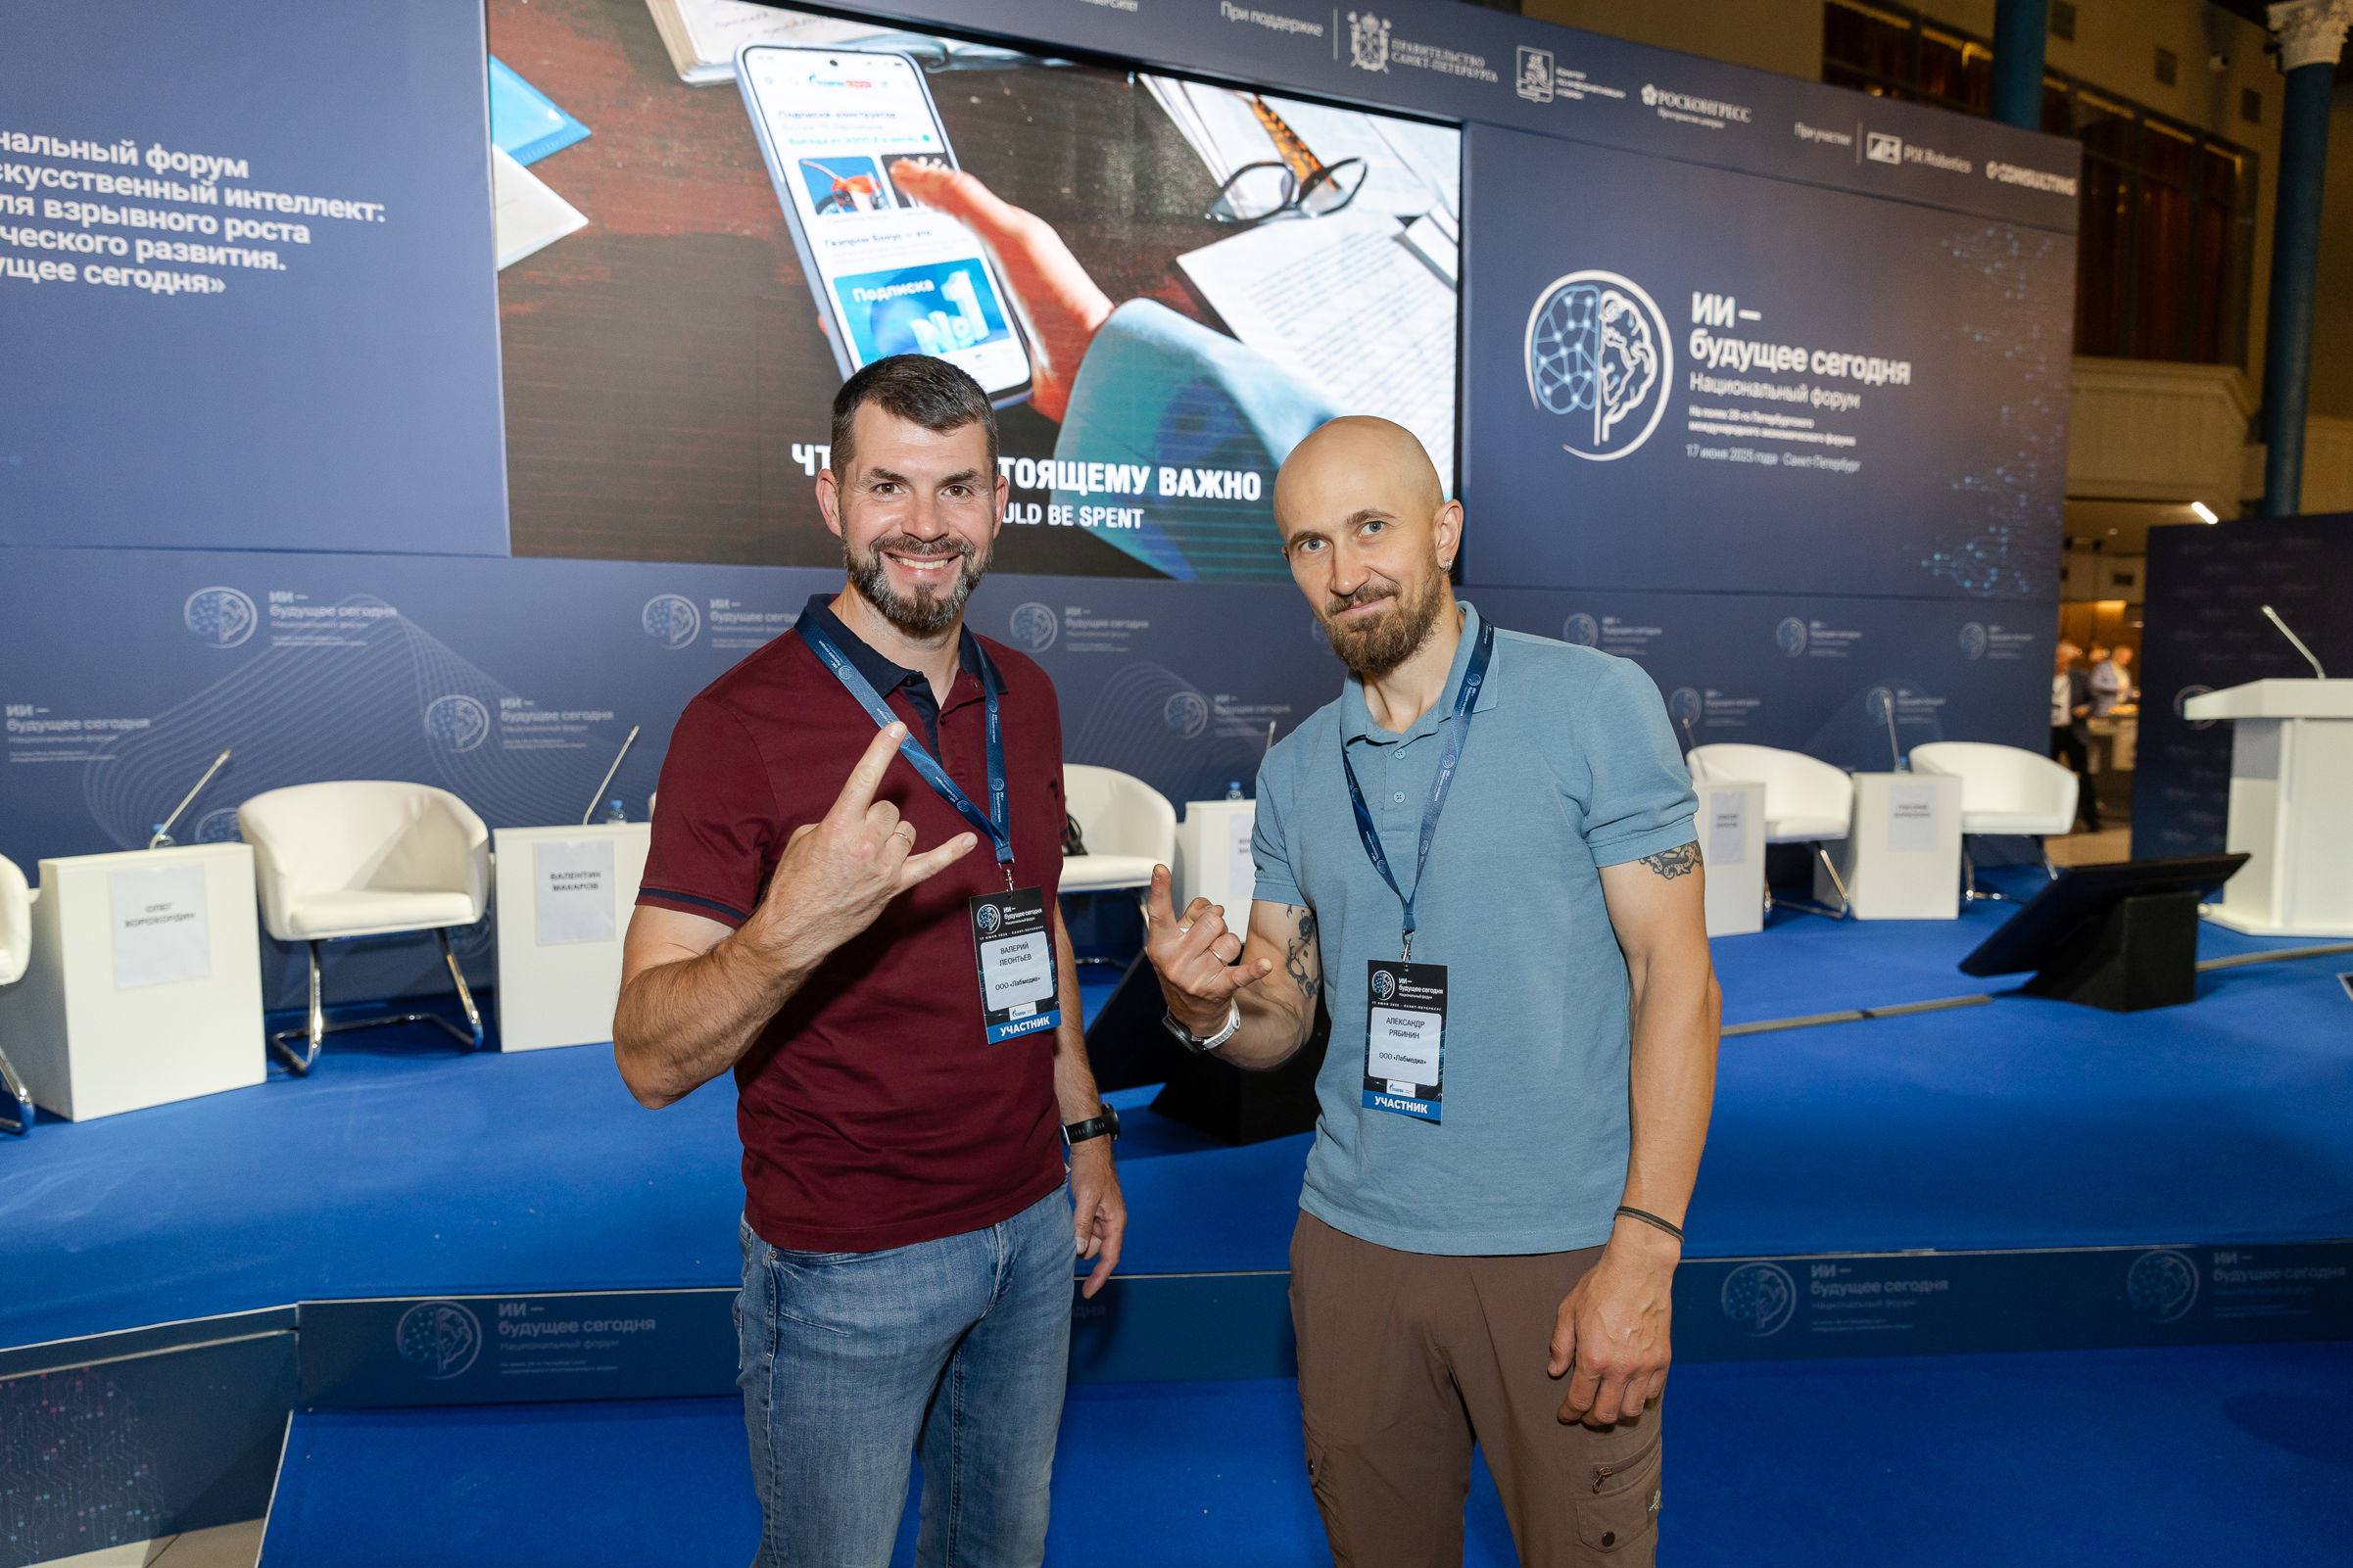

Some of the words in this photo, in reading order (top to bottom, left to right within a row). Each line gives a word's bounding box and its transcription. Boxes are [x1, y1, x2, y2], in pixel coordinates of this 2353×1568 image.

[1221, 2, 1247, 22] При
[1250, 9, 1323, 38] поддержке
[145, 143, 249, 180] форум
[0, 163, 217, 206] кусственный
[224, 186, 386, 223] интеллект:
[43, 199, 218, 235] взрывного
[224, 217, 311, 244] роста
[135, 239, 287, 271] развития.
[83, 264, 226, 296] сегодня»
[852, 279, 935, 303] Подписка
[1692, 291, 1735, 328] ИИ
[1690, 328, 1808, 373] будущее
[1811, 350, 1911, 387] сегодня
[1690, 371, 1808, 404] Национальный
[1810, 386, 1861, 411] форум
[1159, 465, 1262, 501] ВАЖНО
[1047, 504, 1075, 527] BE
[1080, 505, 1144, 530] SPENT
[1000, 941, 1030, 955] ВАЛЕРИЙ
[999, 953, 1032, 967] ЛЕОНТЬЕВ
[995, 982, 1009, 991] ООО
[1399, 984, 1422, 993] будущее
[1422, 986, 1444, 995] сегодня
[1000, 1015, 1050, 1037] УЧАСТНИК
[1386, 1017, 1425, 1028] АЛЕКСАНДР
[1388, 1029, 1419, 1039] РЯБИНИН
[1393, 1054, 1427, 1066] «Лабмедиа»
[1374, 1096, 1428, 1115] УЧАСТНИК
[1811, 1264, 1836, 1278] ИИ
[1811, 1281, 1881, 1298] будущее
[1884, 1279, 1948, 1293] сегодня
[498, 1303, 527, 1317] ИИ
[498, 1320, 579, 1338] будущее
[583, 1318, 655, 1333] сегодня
